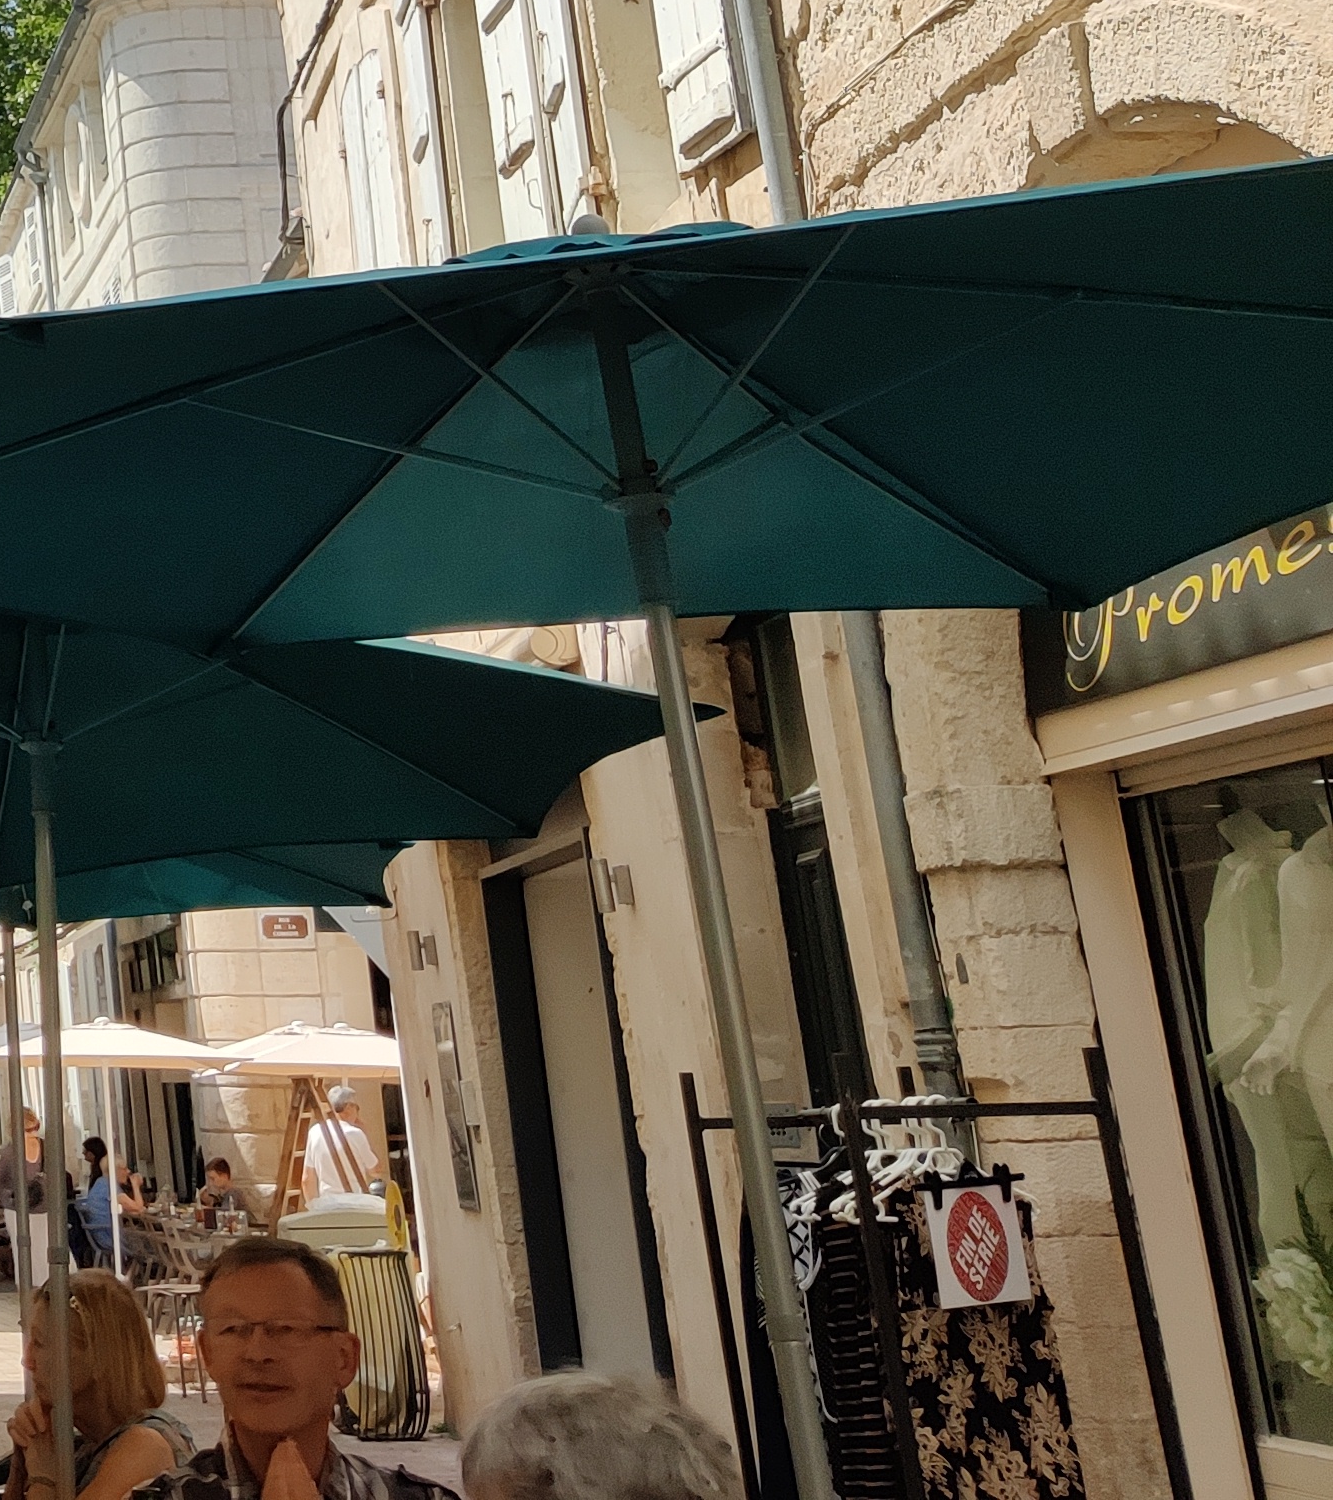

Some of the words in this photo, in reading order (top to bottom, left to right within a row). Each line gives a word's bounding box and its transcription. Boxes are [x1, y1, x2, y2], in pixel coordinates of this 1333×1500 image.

[1063, 512, 1333, 692] Prome
[955, 1232, 977, 1274] FIN
[967, 1204, 987, 1240] DE
[968, 1221, 1001, 1291] SERIE
